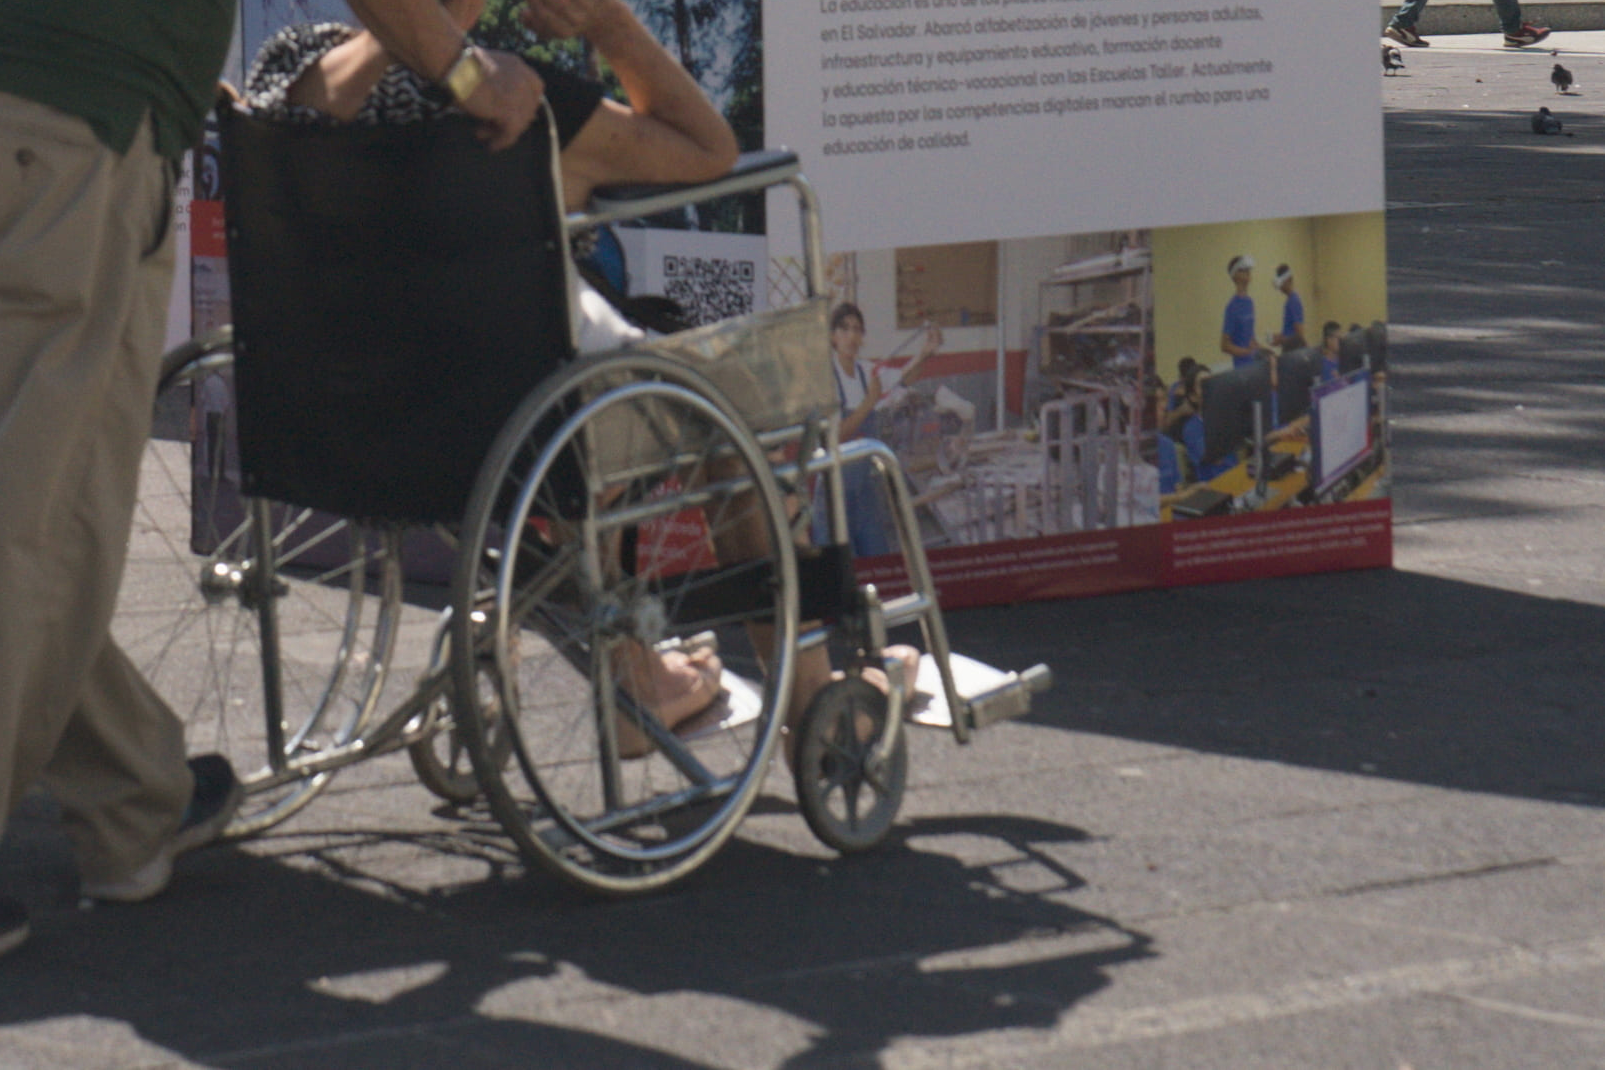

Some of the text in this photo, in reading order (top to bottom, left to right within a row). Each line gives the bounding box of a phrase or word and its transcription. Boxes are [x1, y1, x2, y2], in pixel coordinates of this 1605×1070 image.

[821, 52, 923, 70] infraestructura
[937, 45, 1029, 66] equipamiento
[1103, 37, 1168, 55] formación
[1170, 34, 1222, 51] docente
[822, 86, 1270, 128] la apuesta por las competencias digitales marcan el rumbo para una
[823, 137, 894, 156] educación
[897, 134, 915, 150] de
